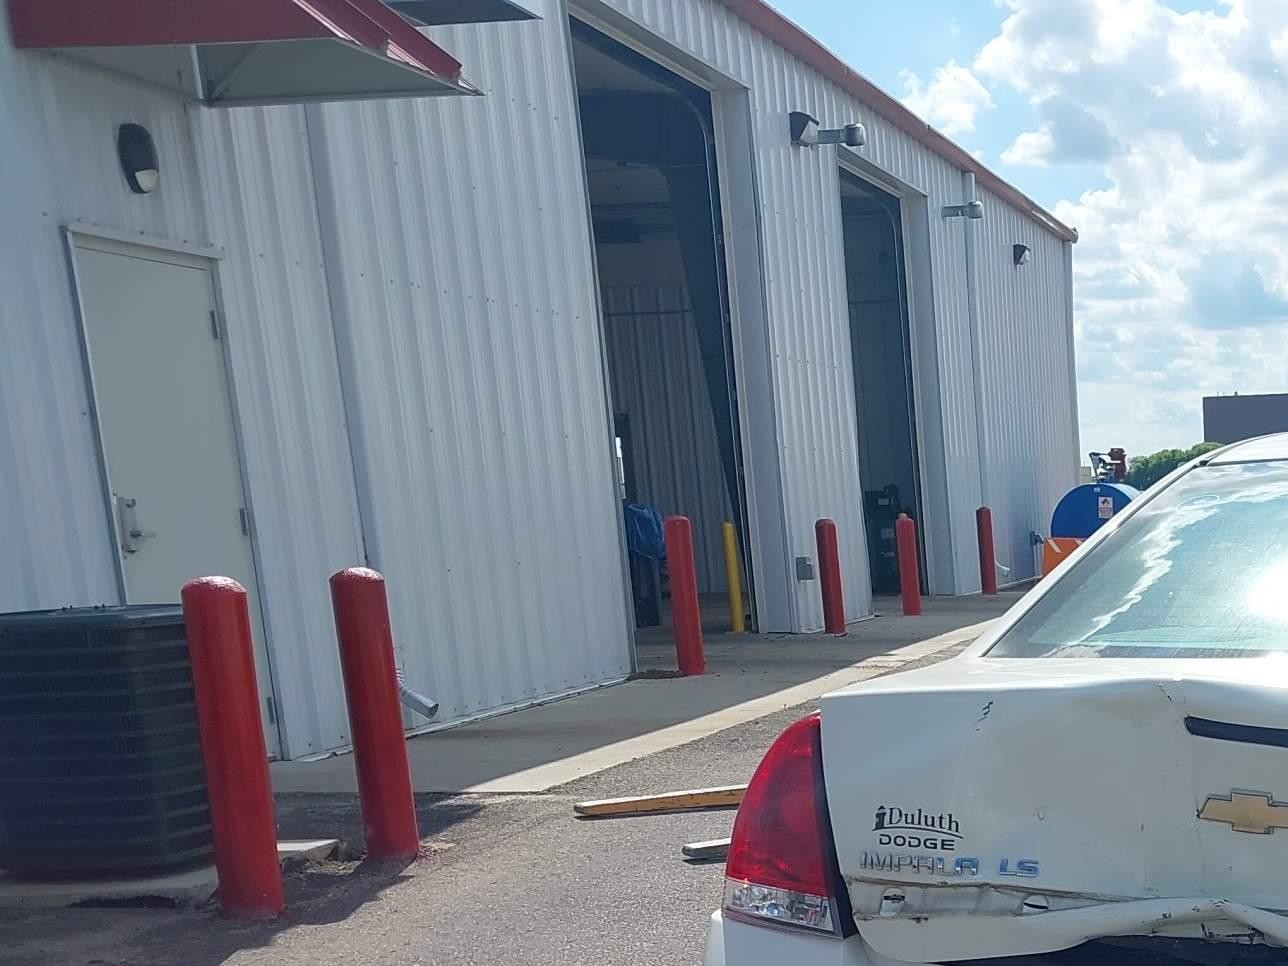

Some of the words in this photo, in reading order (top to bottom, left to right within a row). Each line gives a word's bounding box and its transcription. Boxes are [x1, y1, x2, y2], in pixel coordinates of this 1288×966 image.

[888, 807, 960, 832] Duluth
[879, 834, 955, 850] DODGE
[860, 852, 979, 876] IMPALA
[999, 858, 1039, 877] LS
